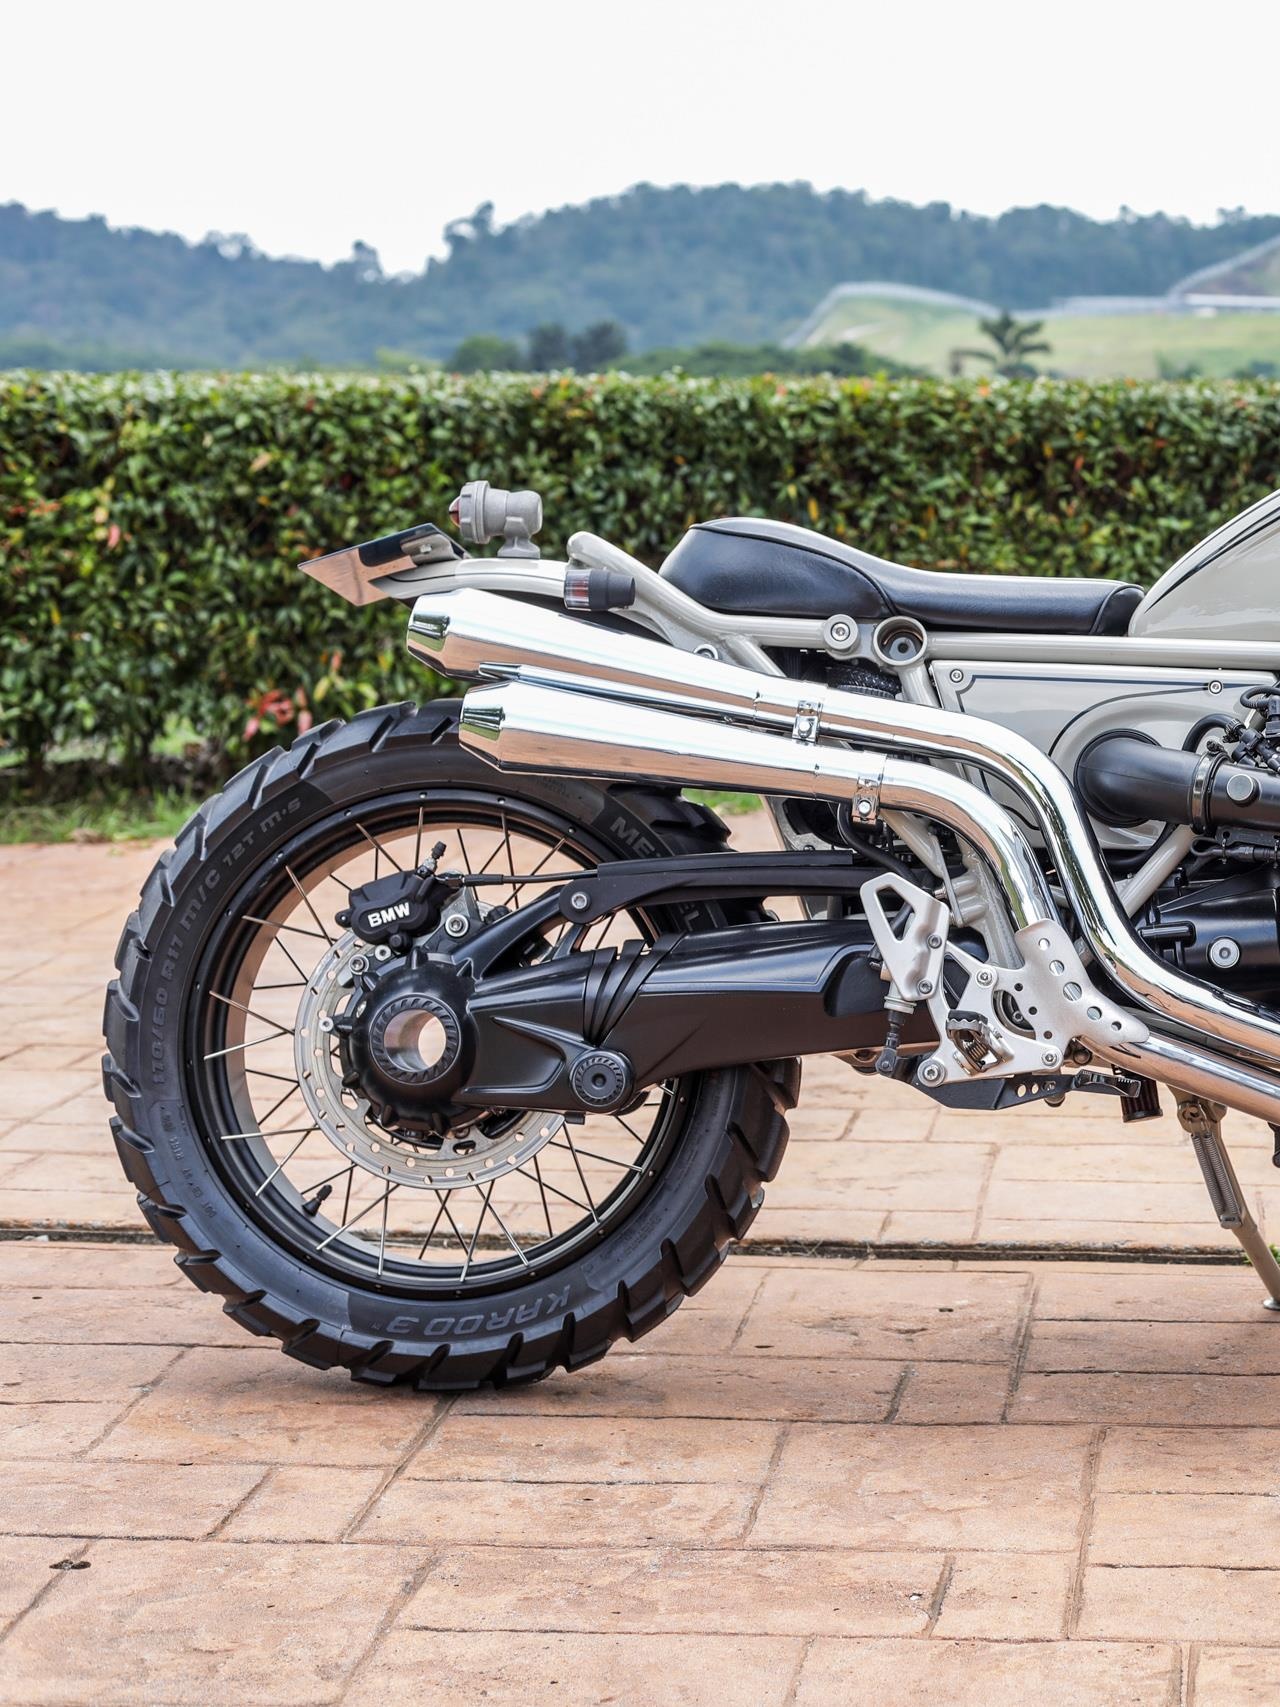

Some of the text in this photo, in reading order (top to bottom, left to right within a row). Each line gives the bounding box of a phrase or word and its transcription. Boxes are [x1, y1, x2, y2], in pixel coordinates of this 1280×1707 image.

[367, 902, 410, 928] BMW
[386, 1284, 571, 1336] KAROO 3
